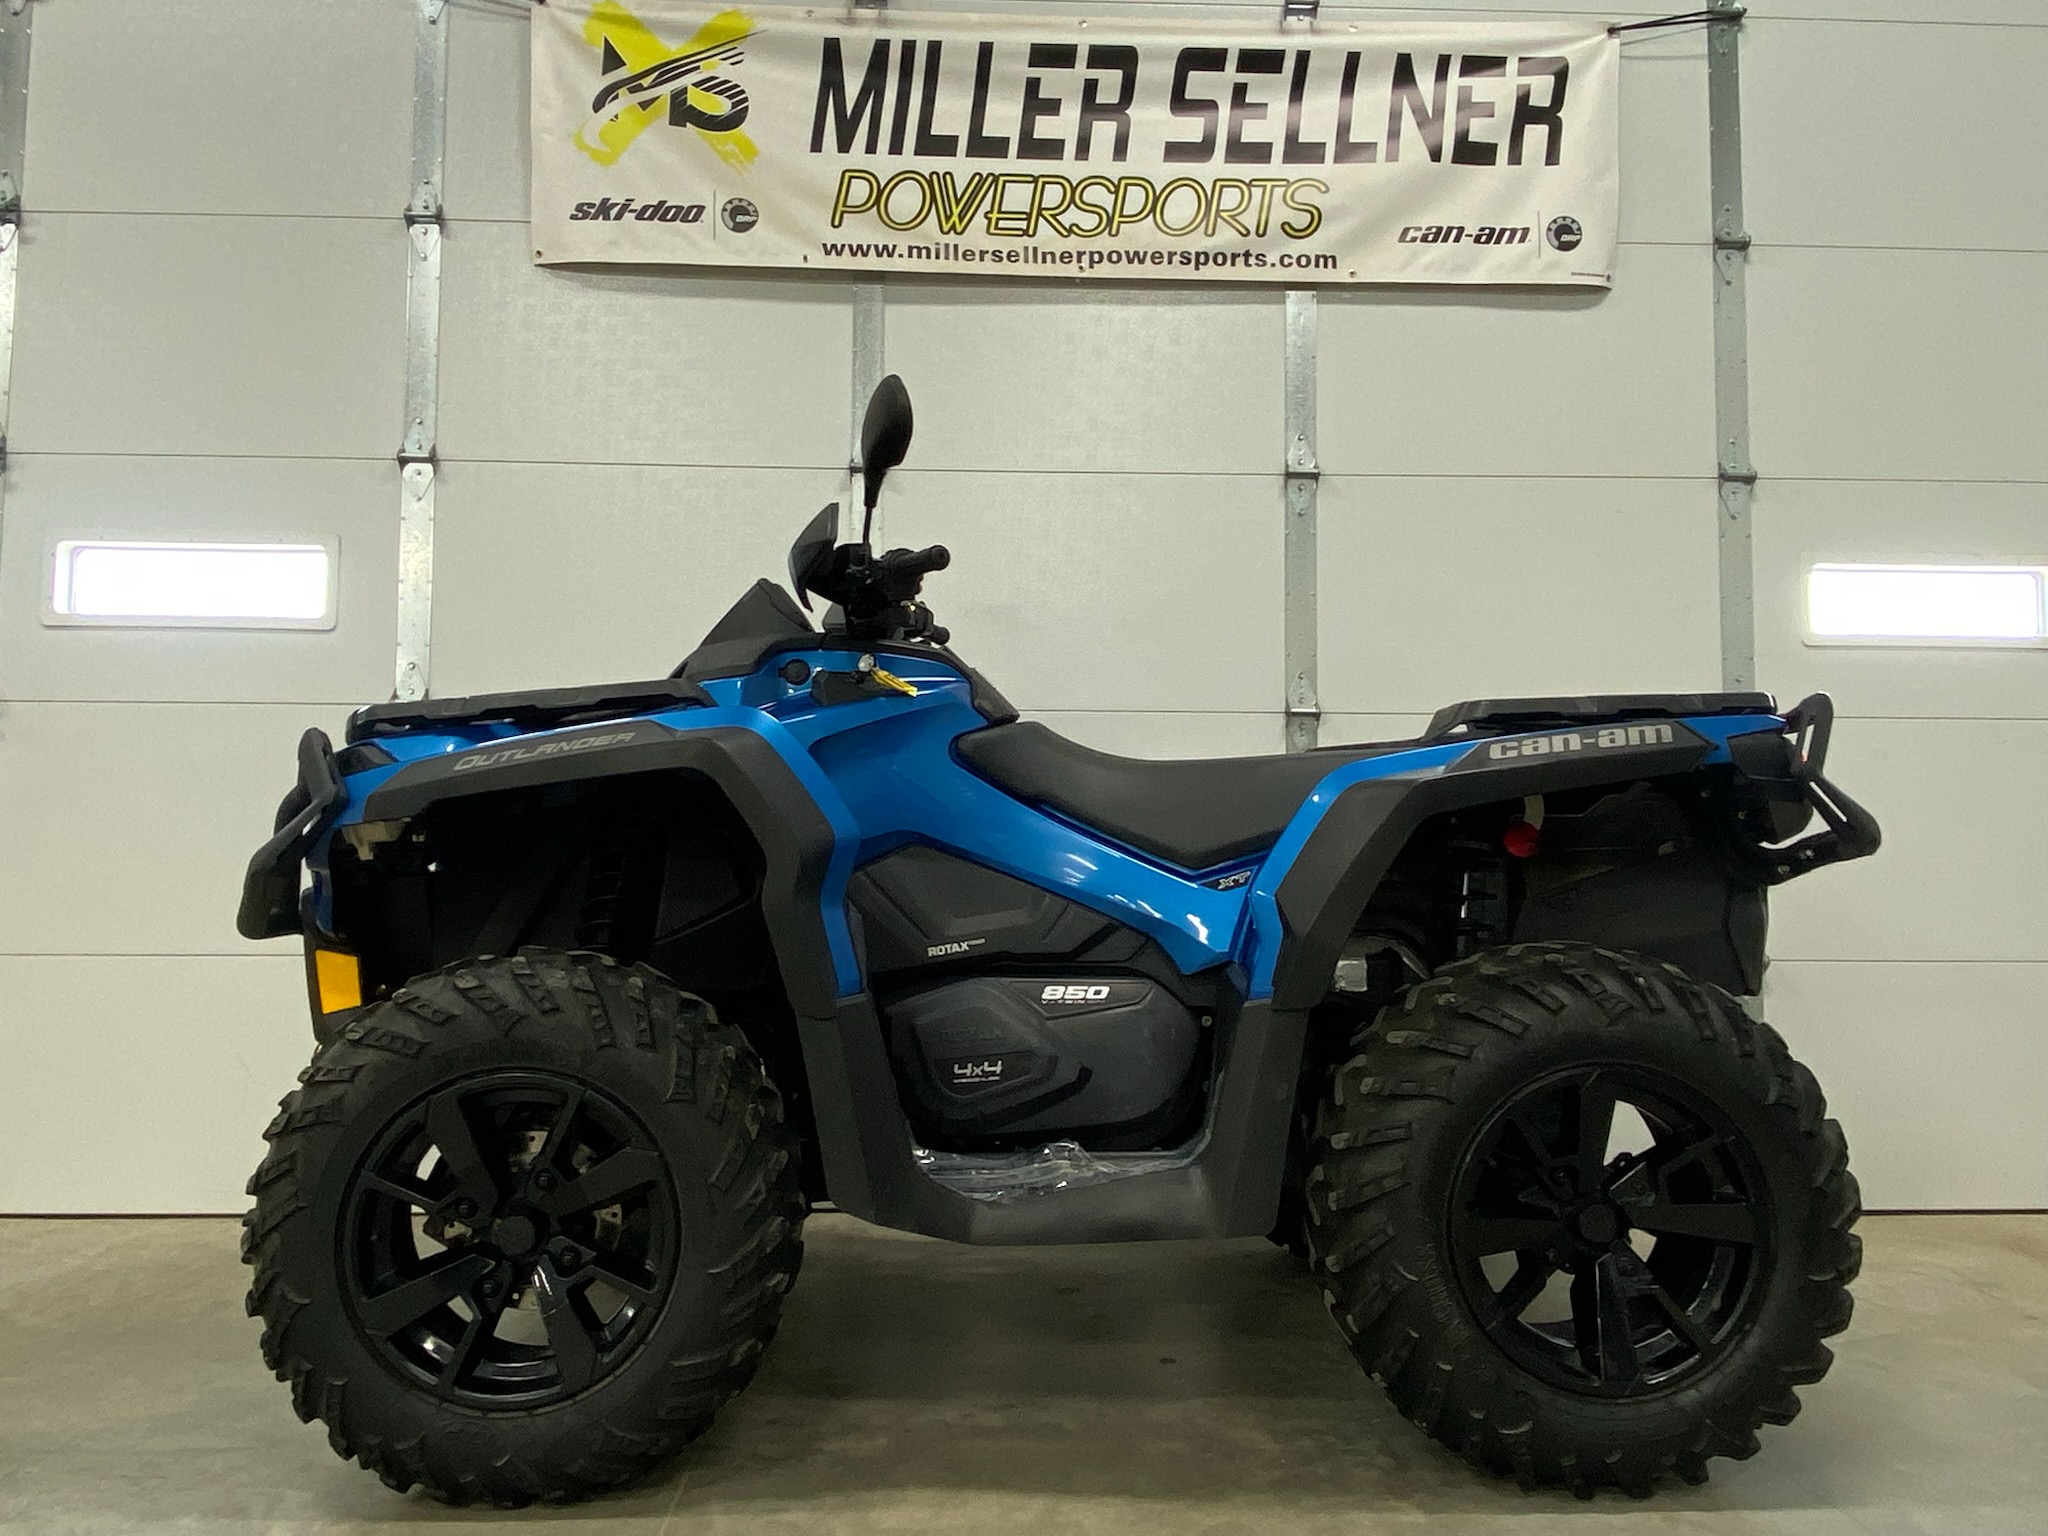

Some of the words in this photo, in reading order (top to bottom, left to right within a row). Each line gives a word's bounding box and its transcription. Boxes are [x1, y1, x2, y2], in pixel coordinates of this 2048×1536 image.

[809, 37, 1140, 163] MILLER
[1162, 46, 1569, 167] SELLNER
[569, 197, 706, 224] ski-doo
[831, 169, 1329, 238] POWERSPORTS
[1397, 224, 1532, 246] can-am
[821, 240, 1338, 271] www.millersellnerpowersports.com
[453, 731, 636, 771] OUTLANDER
[1489, 723, 1673, 760] can-am
[1217, 871, 1252, 890] XT
[927, 940, 970, 958] ROTAX
[1041, 984, 1111, 1000] 850
[953, 1060, 1003, 1077] 4x4
